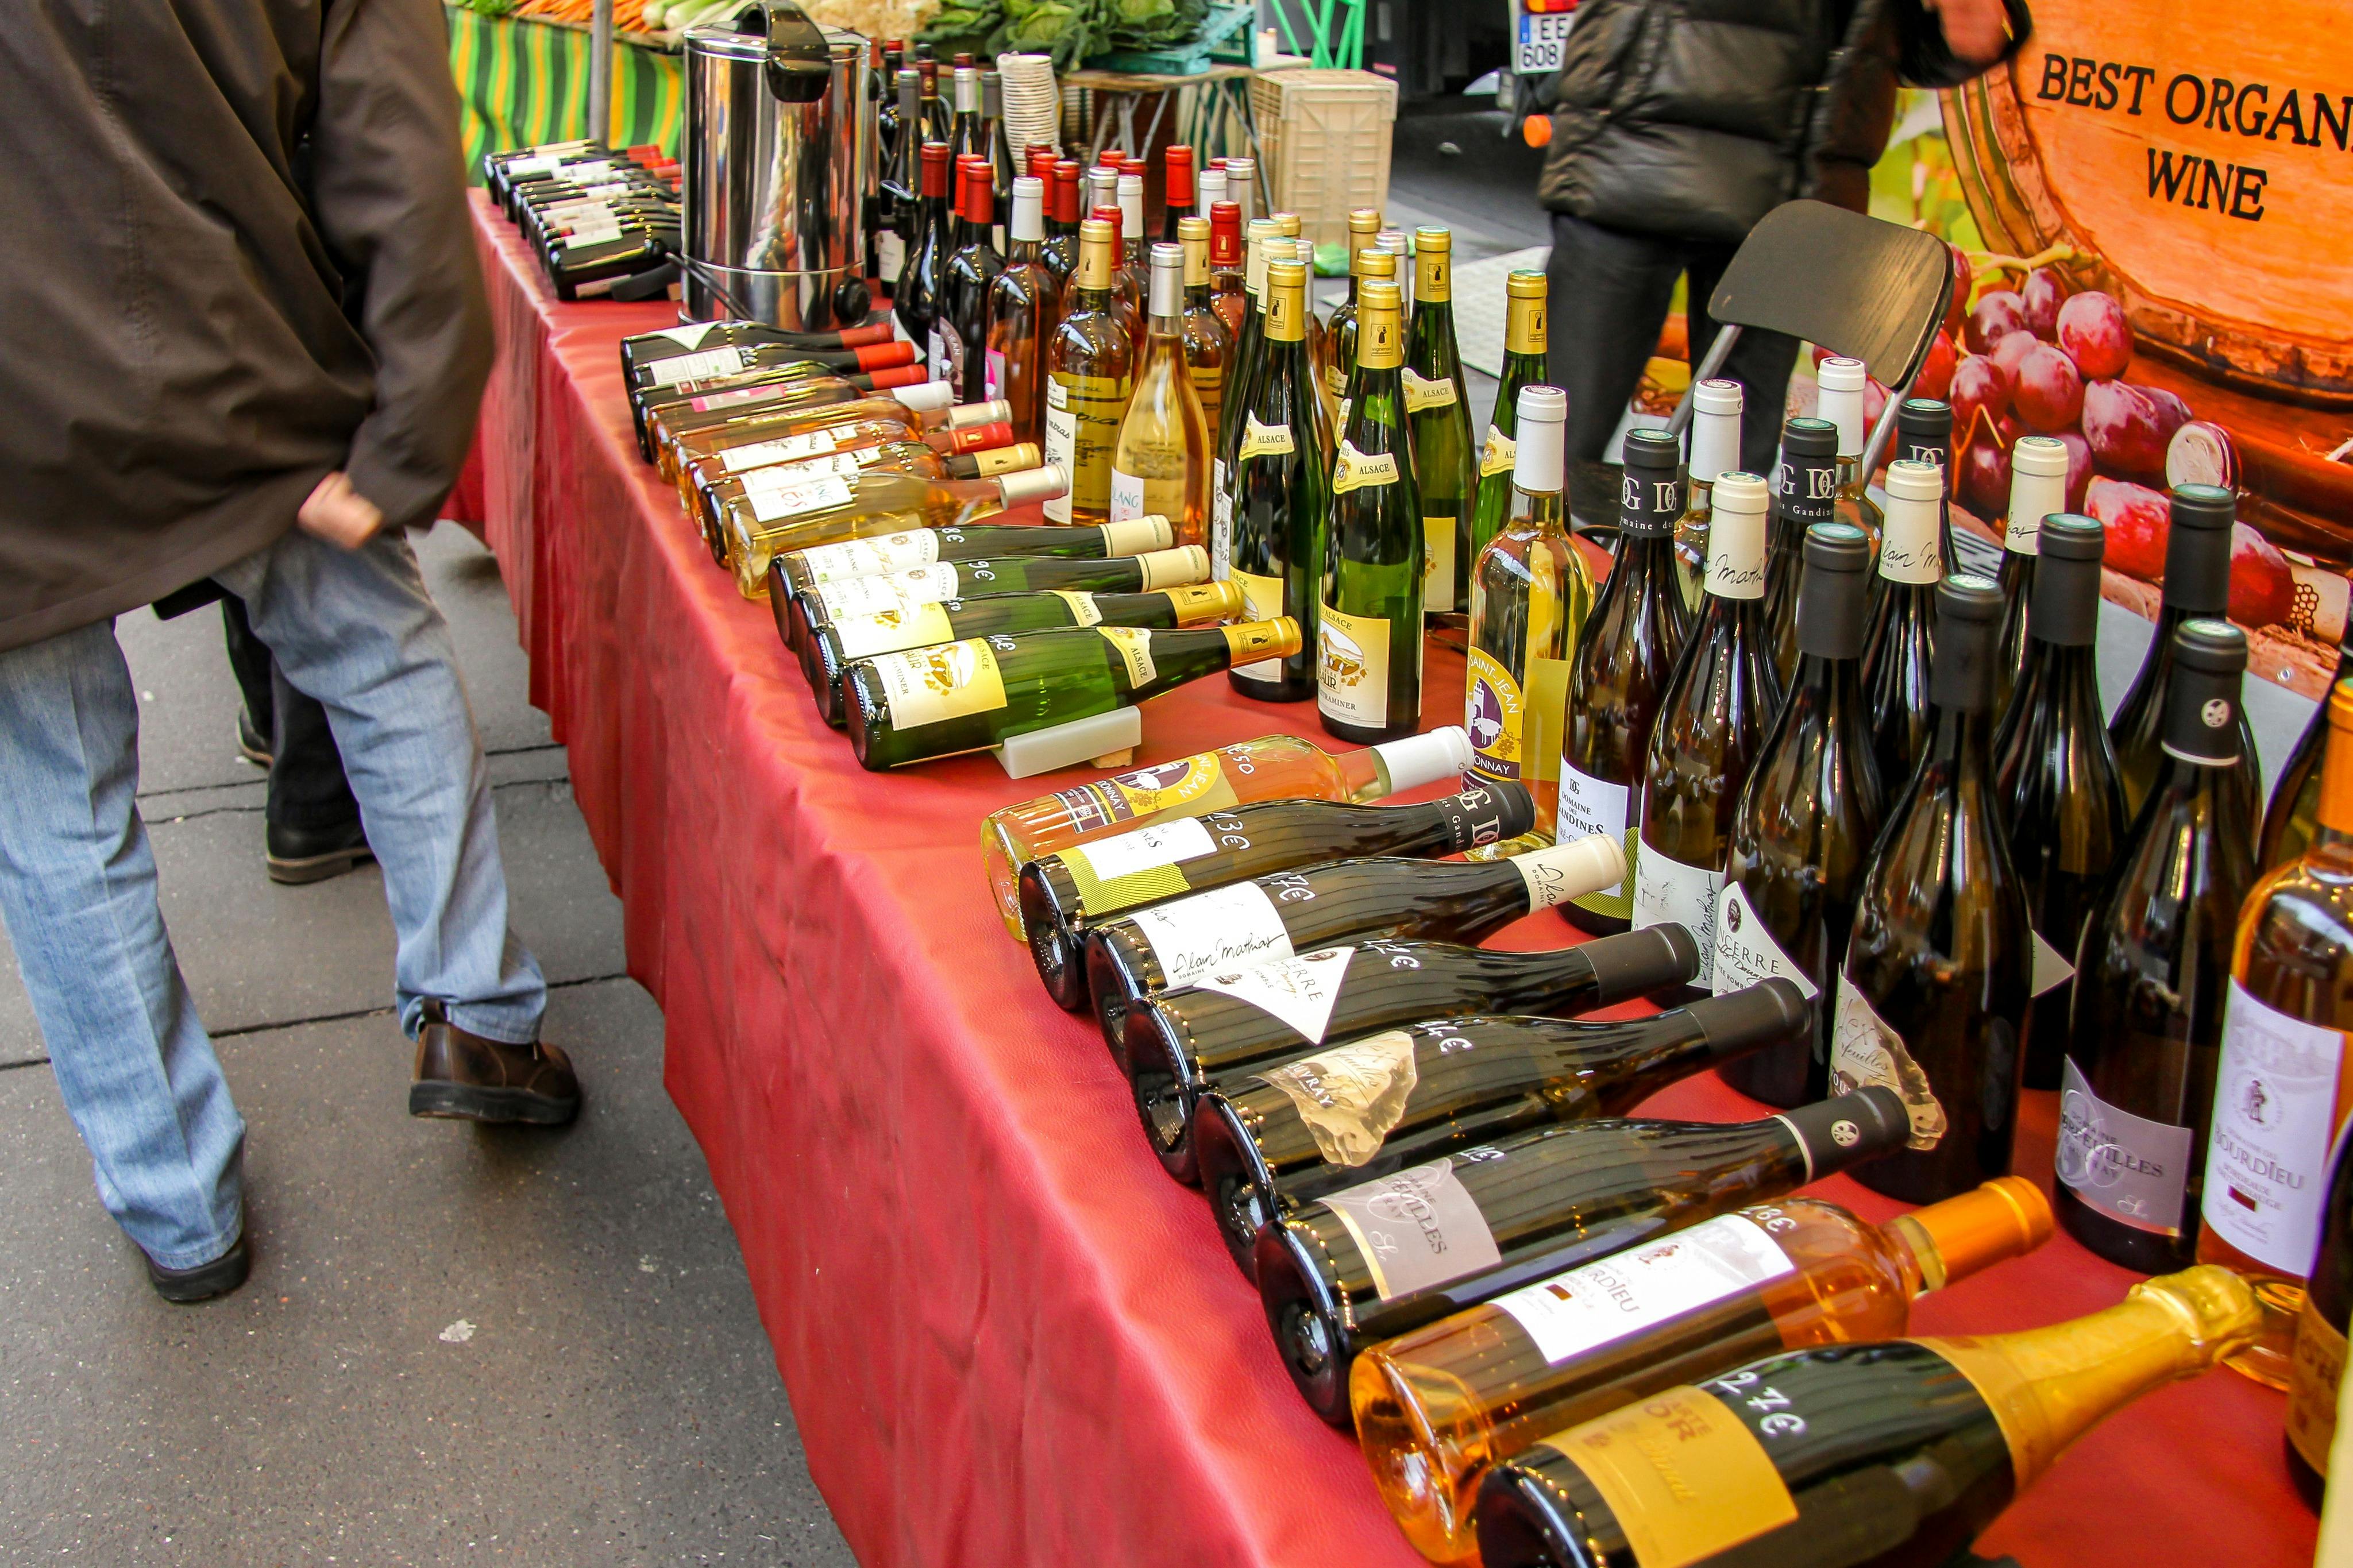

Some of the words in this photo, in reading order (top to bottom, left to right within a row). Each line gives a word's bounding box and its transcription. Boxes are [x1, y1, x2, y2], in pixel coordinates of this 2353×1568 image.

[1523, 44, 1557, 67] 608
[2036, 53, 2155, 115] BEST
[2165, 74, 2353, 153] ORGAN
[2147, 148, 2267, 222] WINE
[1422, 387, 1449, 398] ALSACE
[1257, 434, 1286, 443] ALSACE
[1359, 463, 1390, 475] ALSACE
[941, 527, 965, 543] 8€
[967, 560, 996, 582] 9€
[1074, 595, 1094, 620] ALSACE
[1130, 647, 1148, 678] ALSACE
[1469, 654, 1519, 714] SAINT-JEAN
[1561, 791, 1592, 816] DOMAINE
[1568, 805, 1577, 815] DES
[1208, 812, 1251, 850] 13€
[1532, 869, 1545, 903] DOMAINE
[1178, 968, 1205, 979] DOMAINE
[1833, 1073, 1851, 1095] OU
[1716, 1370, 1806, 1435] 27€
